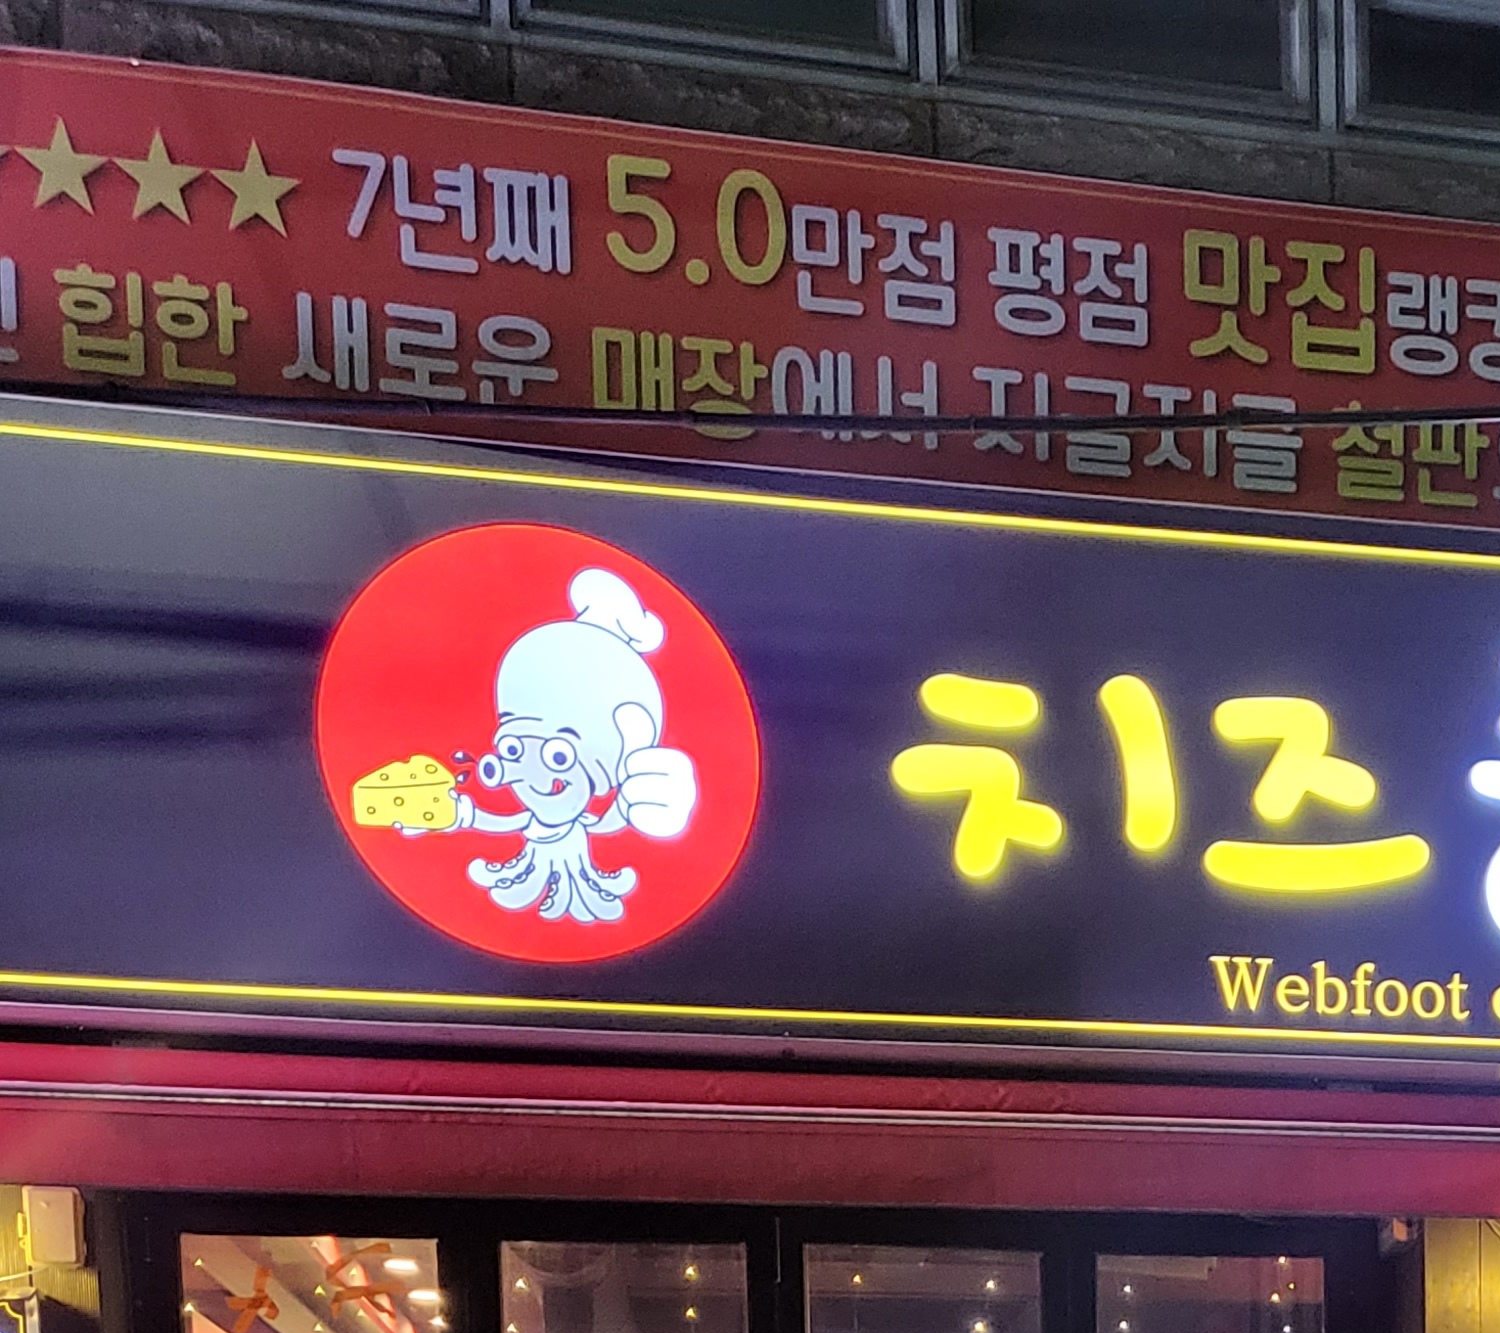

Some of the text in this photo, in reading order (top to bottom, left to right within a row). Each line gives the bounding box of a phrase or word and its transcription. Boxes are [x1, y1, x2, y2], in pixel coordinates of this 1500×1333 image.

[331, 148, 573, 275] 7년째
[986, 226, 1150, 348] 평점
[54, 262, 249, 387] 힙한
[971, 366, 1303, 494] 지글지글
[888, 670, 1434, 894] 치즈
[1208, 954, 1471, 1022] Webfoot
